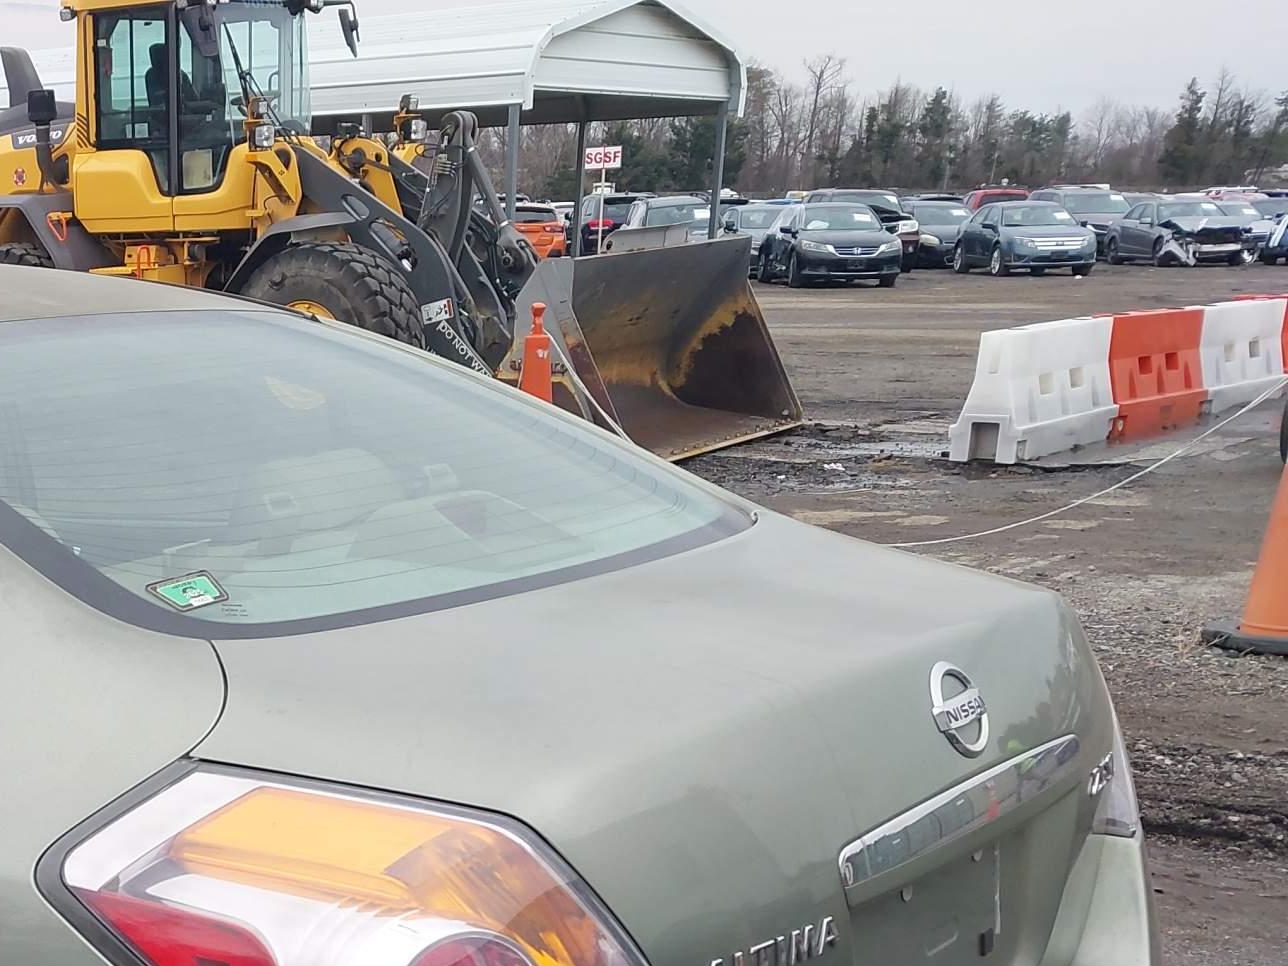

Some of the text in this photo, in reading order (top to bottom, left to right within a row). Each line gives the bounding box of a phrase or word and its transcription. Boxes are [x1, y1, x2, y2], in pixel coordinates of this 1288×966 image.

[17, 130, 62, 145] VOO
[585, 151, 621, 165] SGSF
[438, 322, 454, 339] DO
[452, 338, 473, 360] NOT
